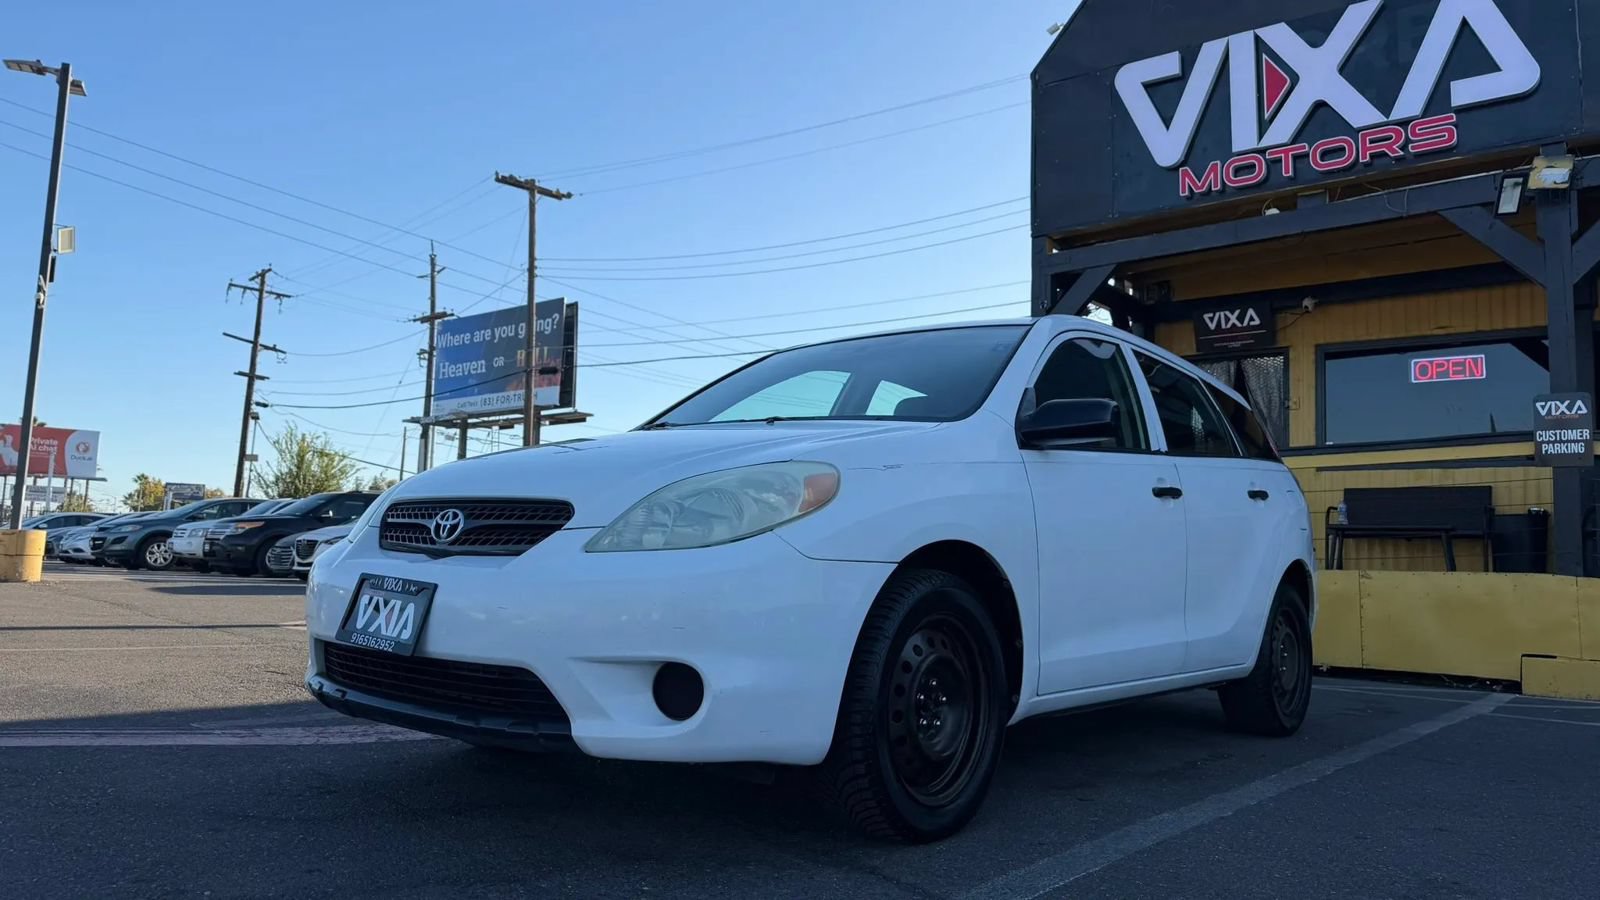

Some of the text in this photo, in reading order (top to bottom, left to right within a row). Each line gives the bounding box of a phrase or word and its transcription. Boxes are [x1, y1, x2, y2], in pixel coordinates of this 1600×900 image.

[1114, 0, 1541, 168] VIXA
[1178, 113, 1458, 197] MOTORS
[1203, 307, 1261, 330] VIXA
[437, 313, 560, 349] Where are you gng?
[439, 359, 487, 379] Heaven
[492, 356, 505, 367] OR
[1415, 357, 1482, 380] OPEN
[1535, 400, 1588, 416] VIXA
[1536, 428, 1590, 442] CUSTOMER
[1541, 442, 1585, 455] PARKING
[350, 632, 395, 652] 9165162952
